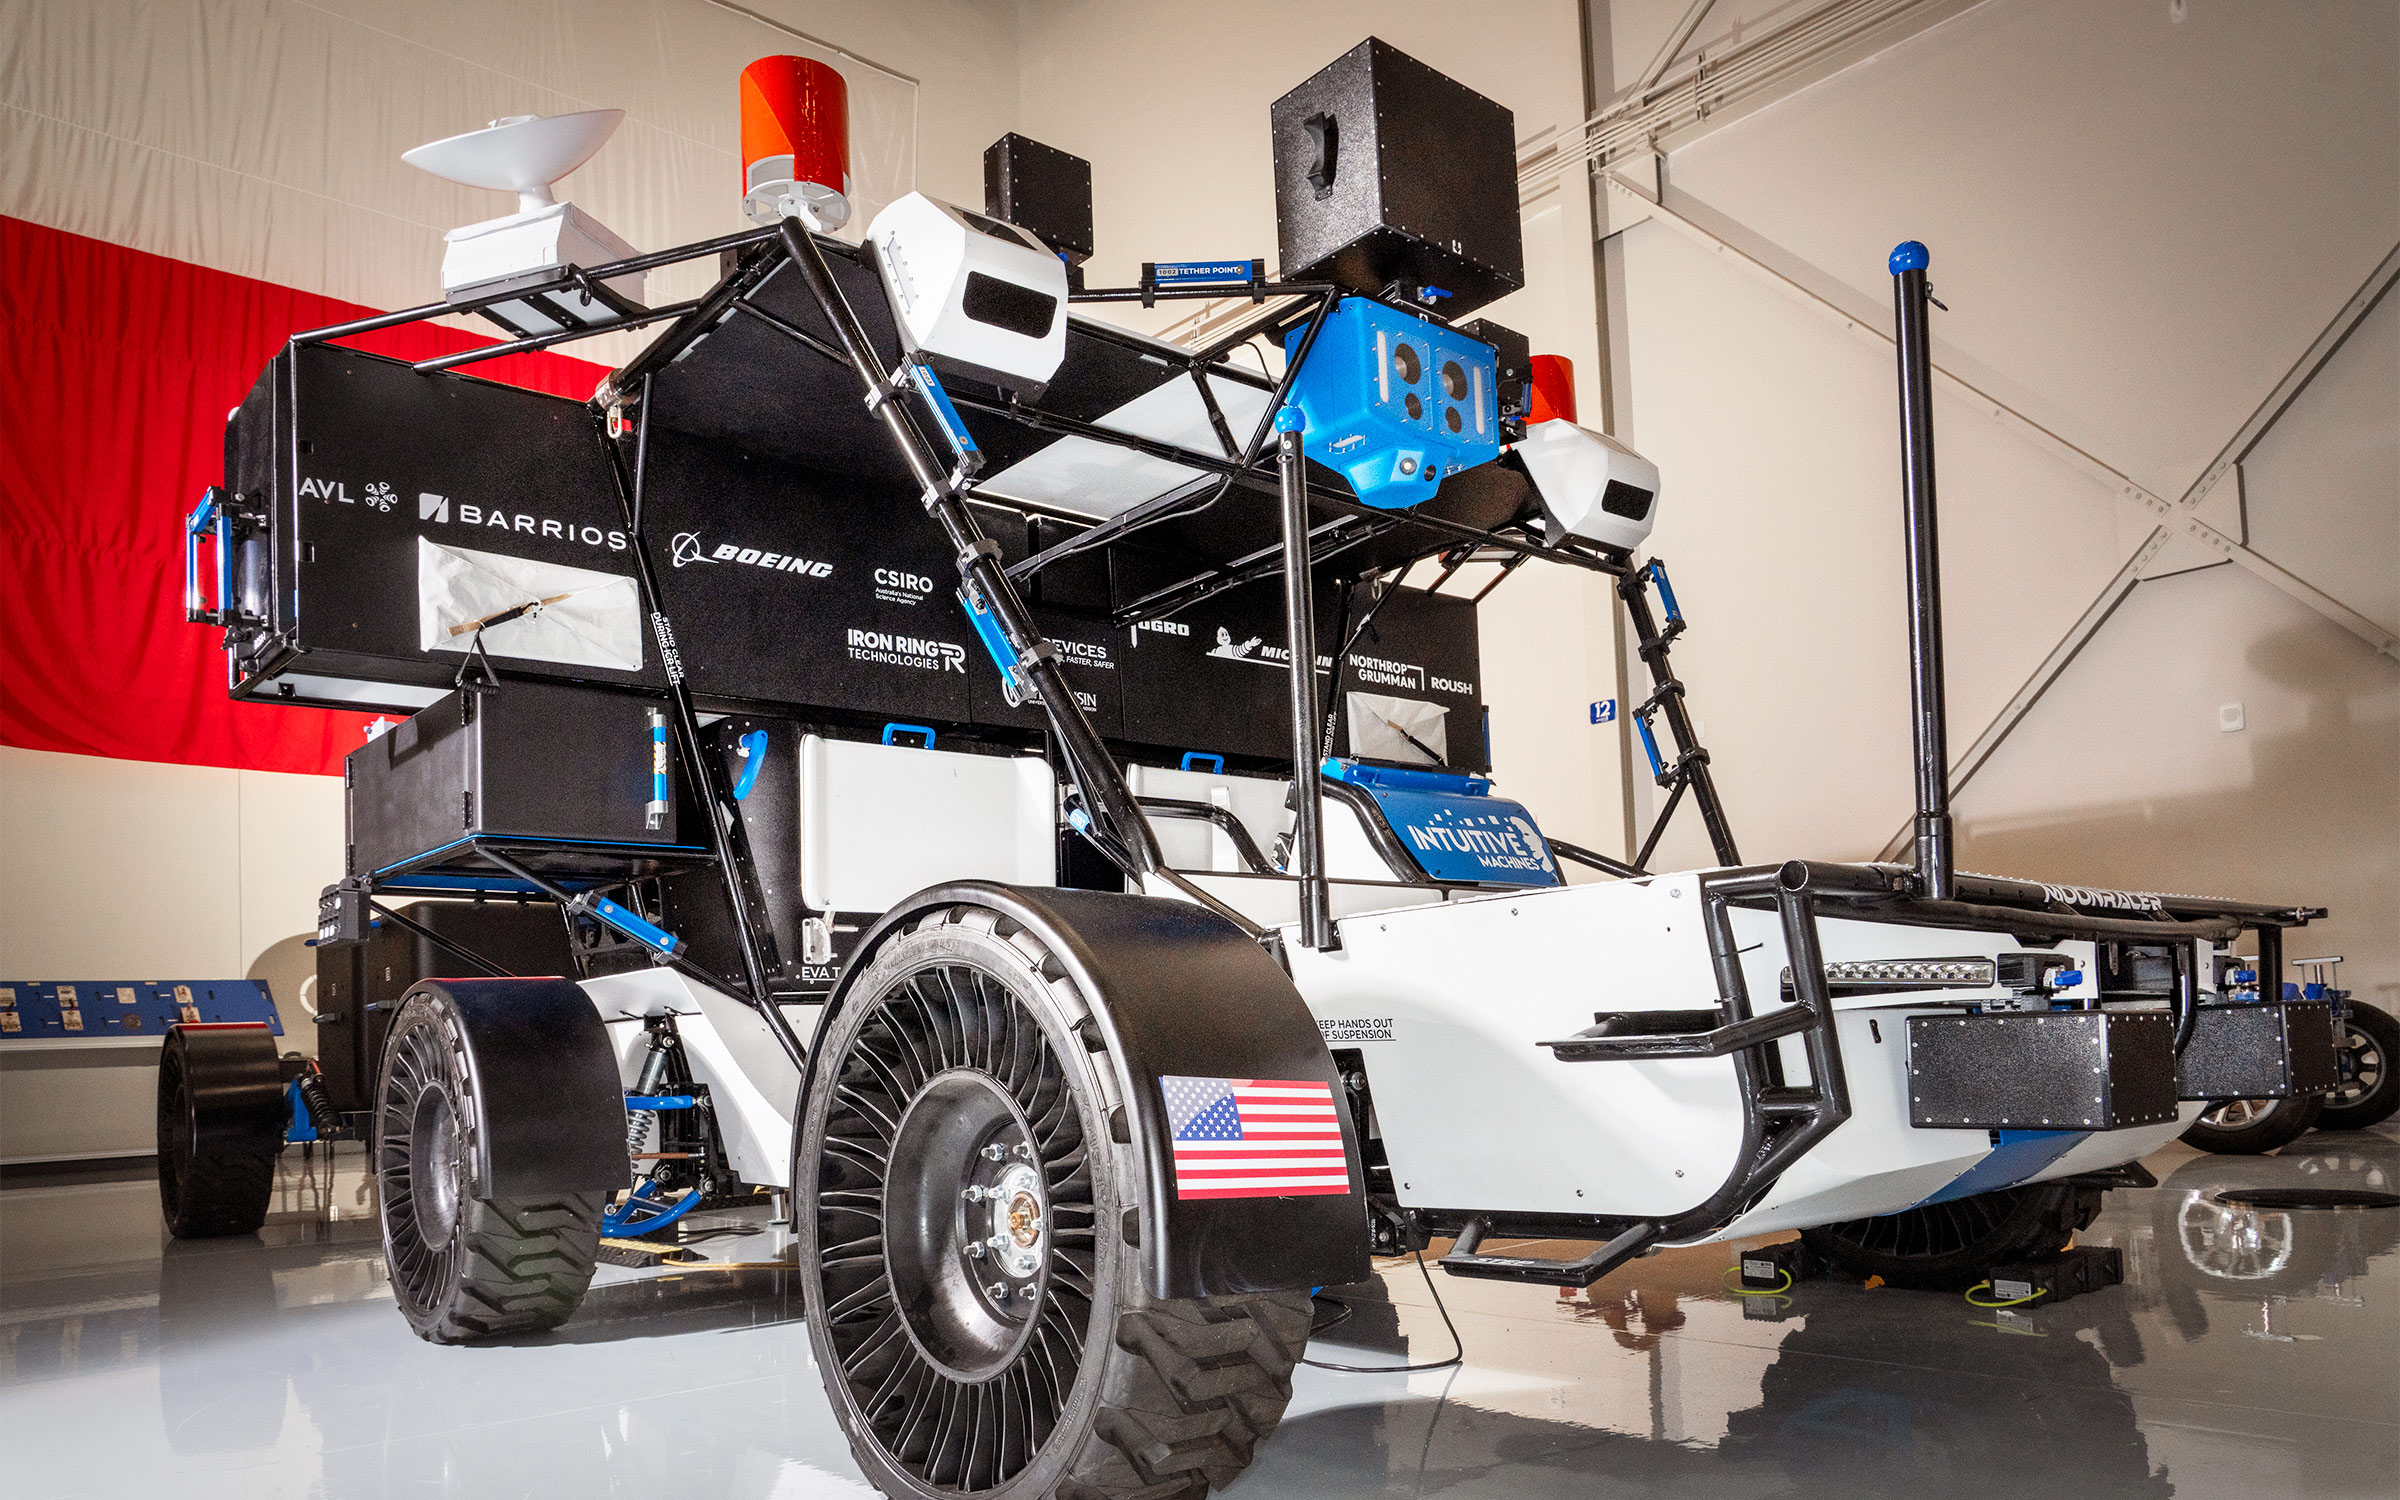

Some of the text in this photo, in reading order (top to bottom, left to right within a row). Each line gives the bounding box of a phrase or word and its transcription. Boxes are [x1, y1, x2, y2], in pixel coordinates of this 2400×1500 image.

[1178, 267, 1211, 275] TETHER
[1212, 266, 1238, 274] POINT
[299, 477, 354, 503] AVL
[460, 504, 627, 550] BARRIOS
[712, 543, 833, 578] BOEING
[874, 568, 933, 593] CSIRO
[875, 587, 924, 601] Australia's National
[875, 593, 917, 606] Science Agency
[652, 611, 681, 685] DURING ICR LIFT
[662, 616, 685, 678] STAND CLEAR
[847, 628, 938, 658] IRON RING
[1042, 637, 1107, 659] EVICES
[848, 647, 939, 671] TECHNOLOGIES
[1066, 655, 1092, 667] FASTER,
[1093, 660, 1115, 670] SAFER
[1260, 645, 1333, 668] MICIN
[1349, 653, 1408, 675] NORTHROP
[1358, 668, 1416, 689] GRUMMAN
[1431, 676, 1473, 695] ROUSH
[1594, 700, 1611, 718] 12
[1325, 713, 1333, 735] CLEAR
[1322, 735, 1331, 757] STAND
[1407, 825, 1528, 856] INTUITIVE
[1476, 854, 1540, 871] MACHINES
[2042, 884, 2162, 911] MOONRACER
[801, 966, 830, 978] EVA
[1316, 1018, 1393, 1029] EEP HANDS OUT
[1331, 1029, 1392, 1040] SUSPENSION
